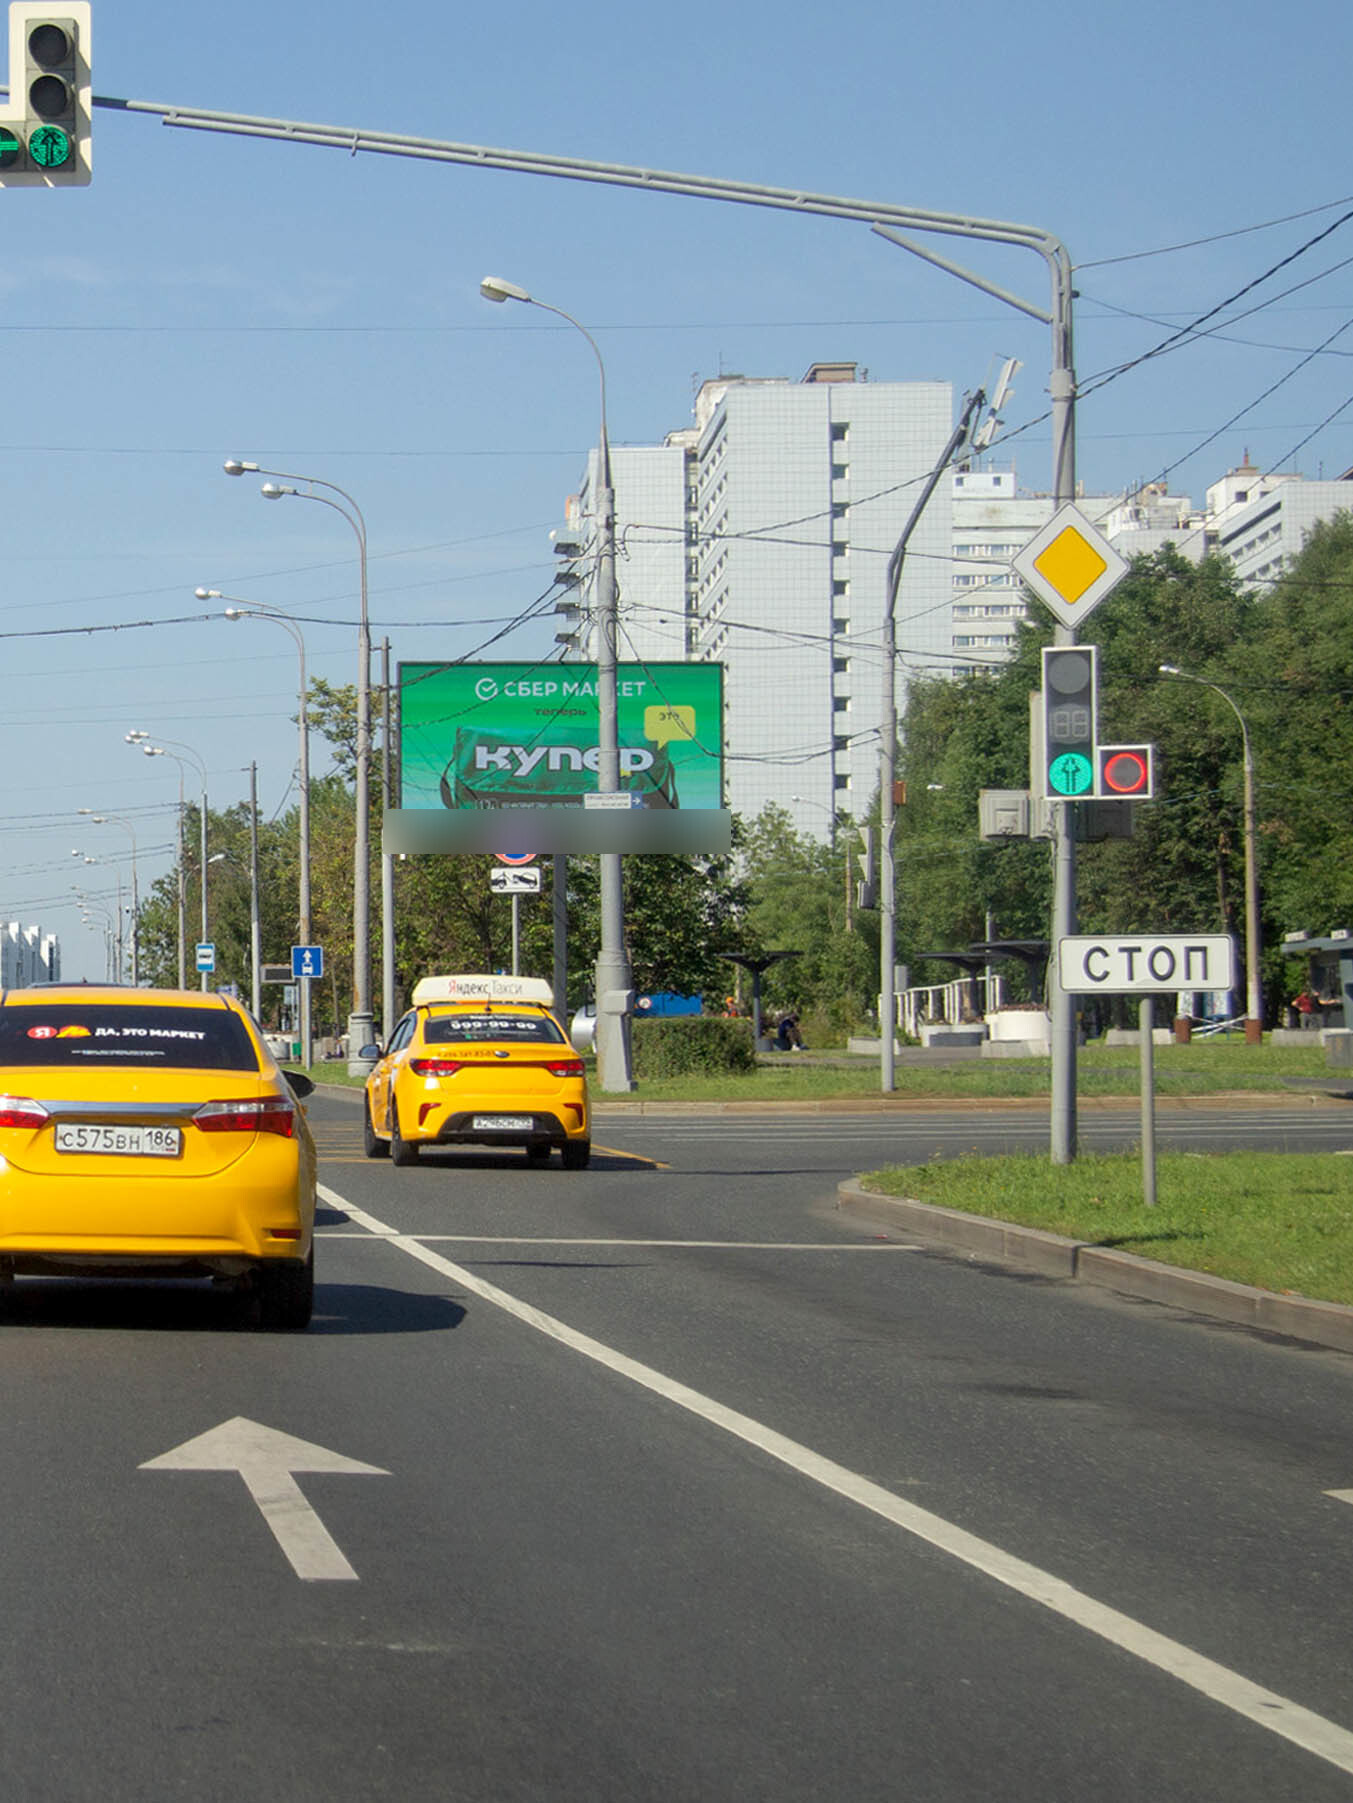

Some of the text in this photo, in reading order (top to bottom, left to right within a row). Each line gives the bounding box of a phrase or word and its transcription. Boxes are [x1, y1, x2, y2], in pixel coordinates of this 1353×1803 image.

[503, 681, 646, 697] СБЕР МАЕТ
[1083, 945, 1209, 982] СТОП
[448, 979, 523, 995] Яндекс Такси
[34, 1027, 206, 1041] Я ДА, ЭТО МАРКЕТ
[145, 1130, 175, 1147] 186
